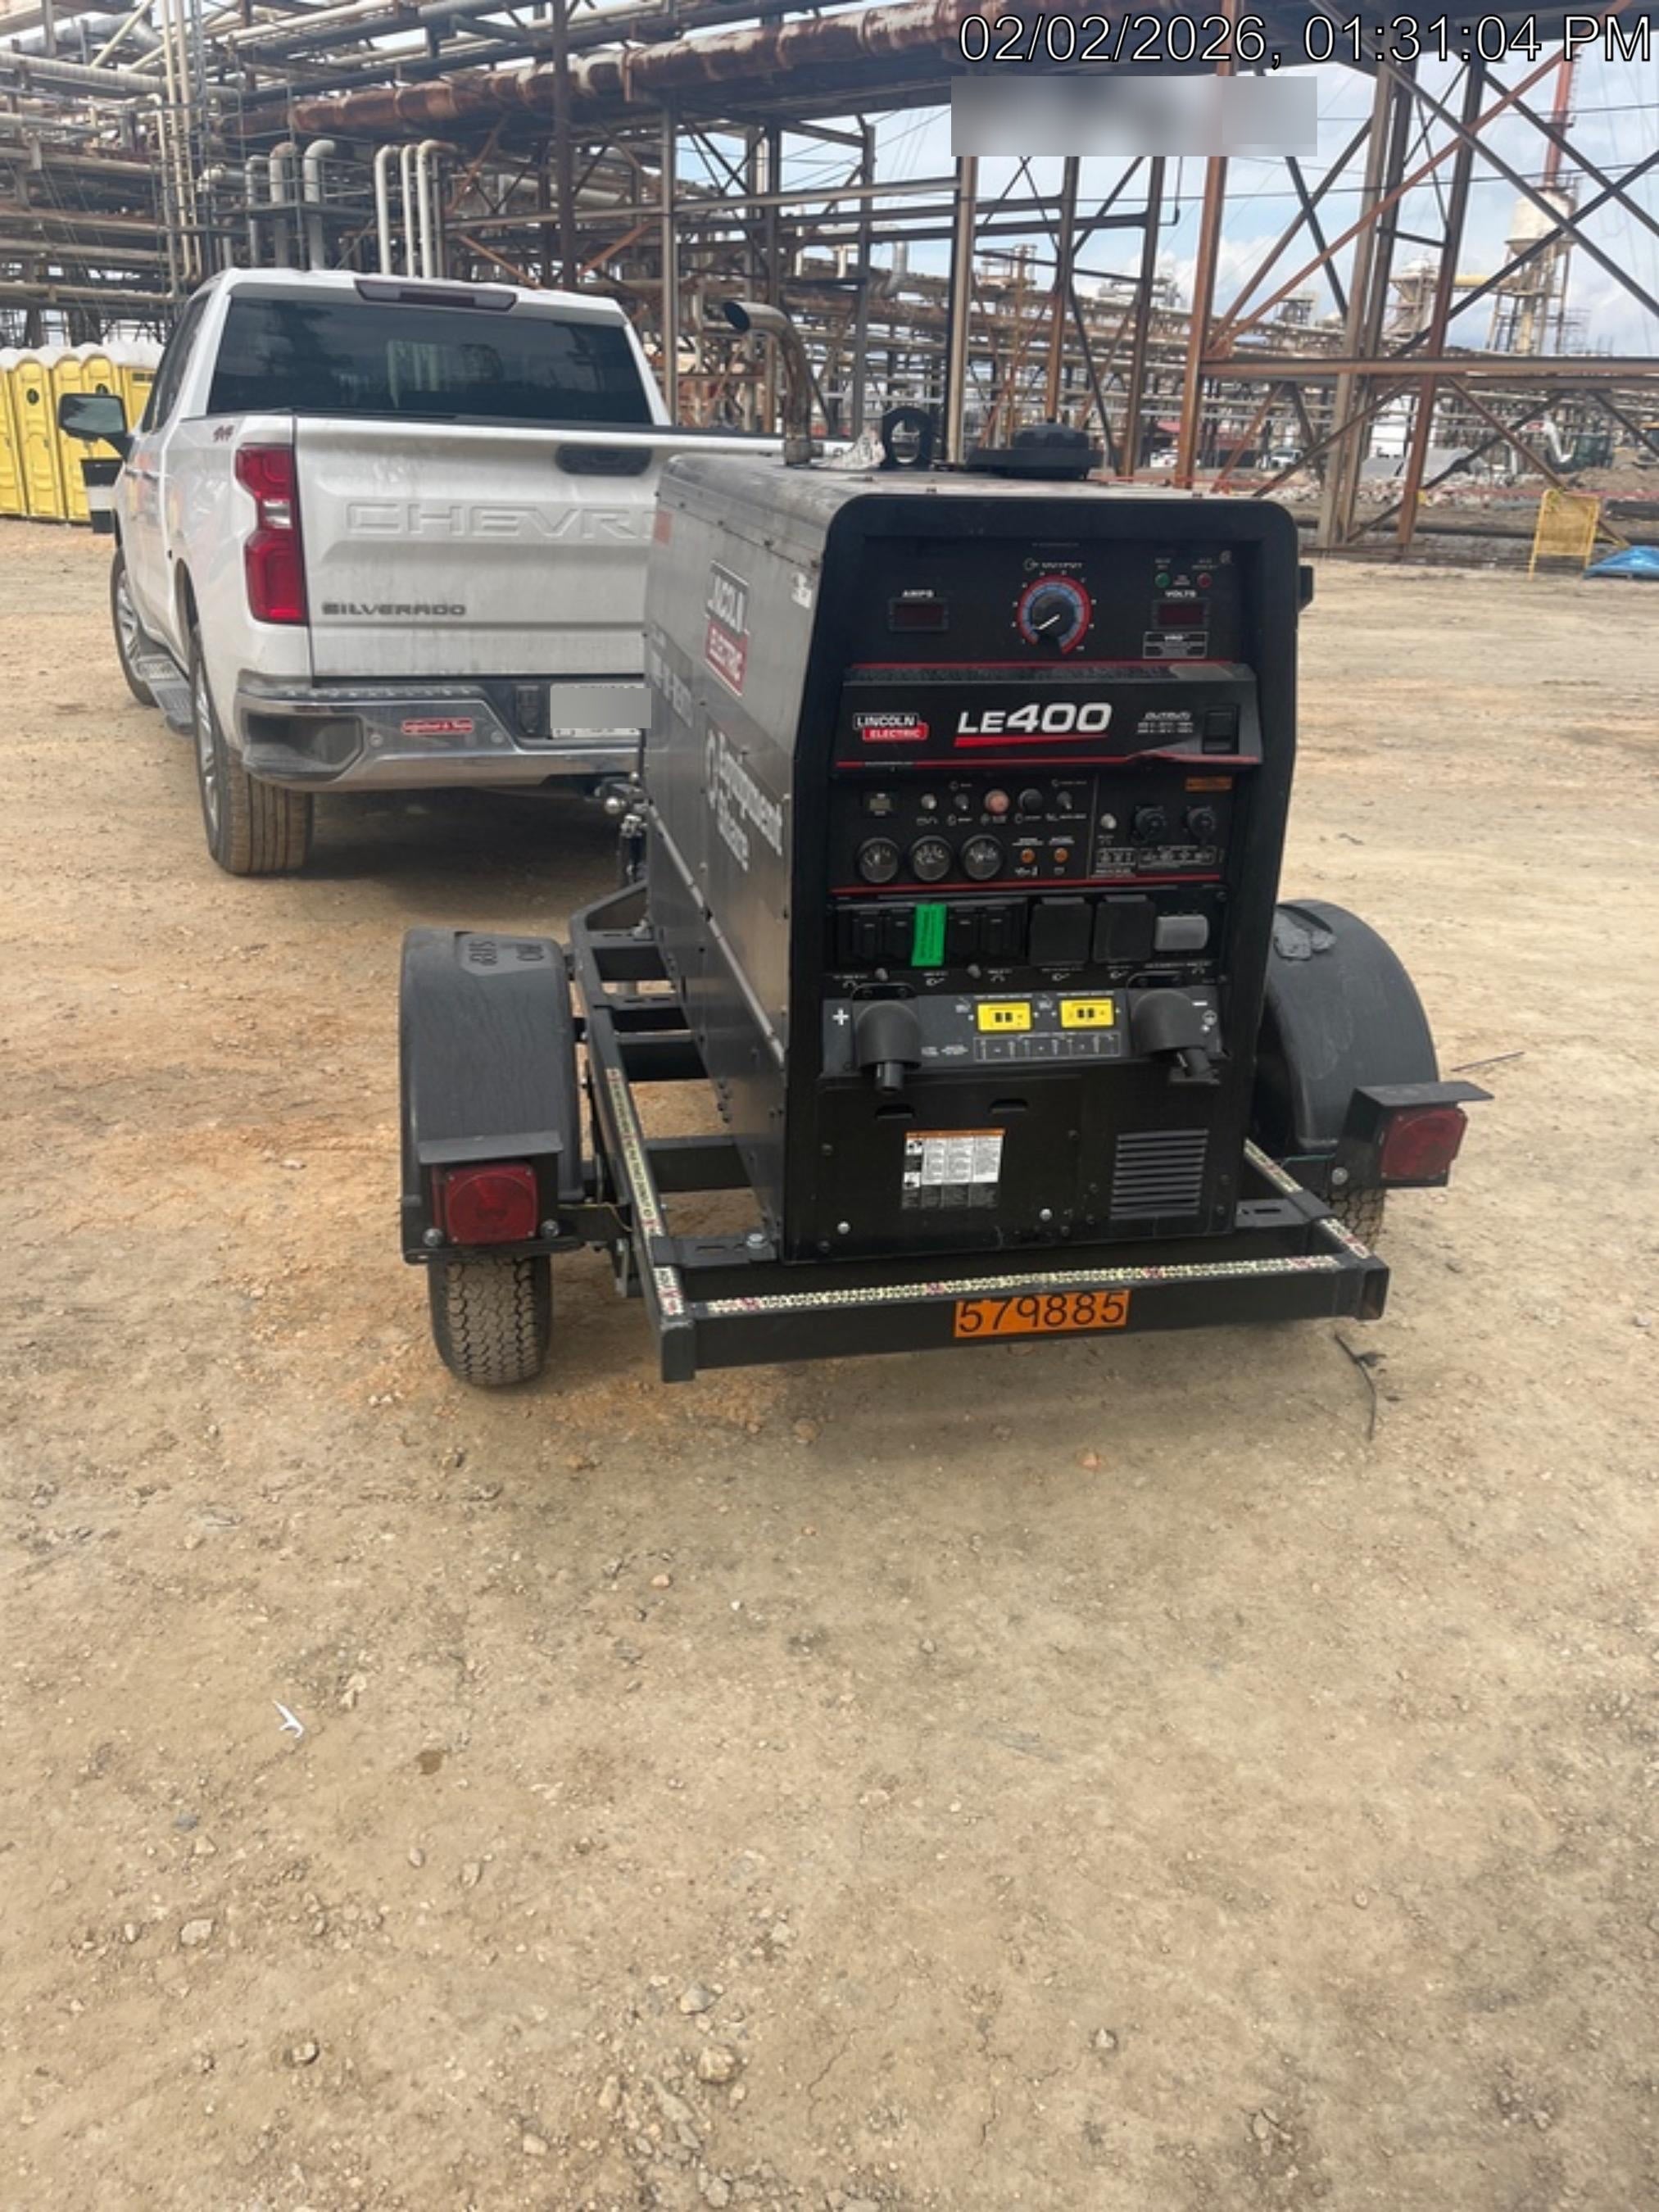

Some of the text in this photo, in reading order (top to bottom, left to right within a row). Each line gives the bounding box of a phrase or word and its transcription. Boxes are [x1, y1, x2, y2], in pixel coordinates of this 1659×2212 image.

[347, 503, 655, 540] CHEVR
[322, 602, 466, 616] SILVERADO
[856, 716, 917, 727] LINCOLN
[957, 702, 1113, 733] LE400
[958, 1291, 1126, 1333] 579885
